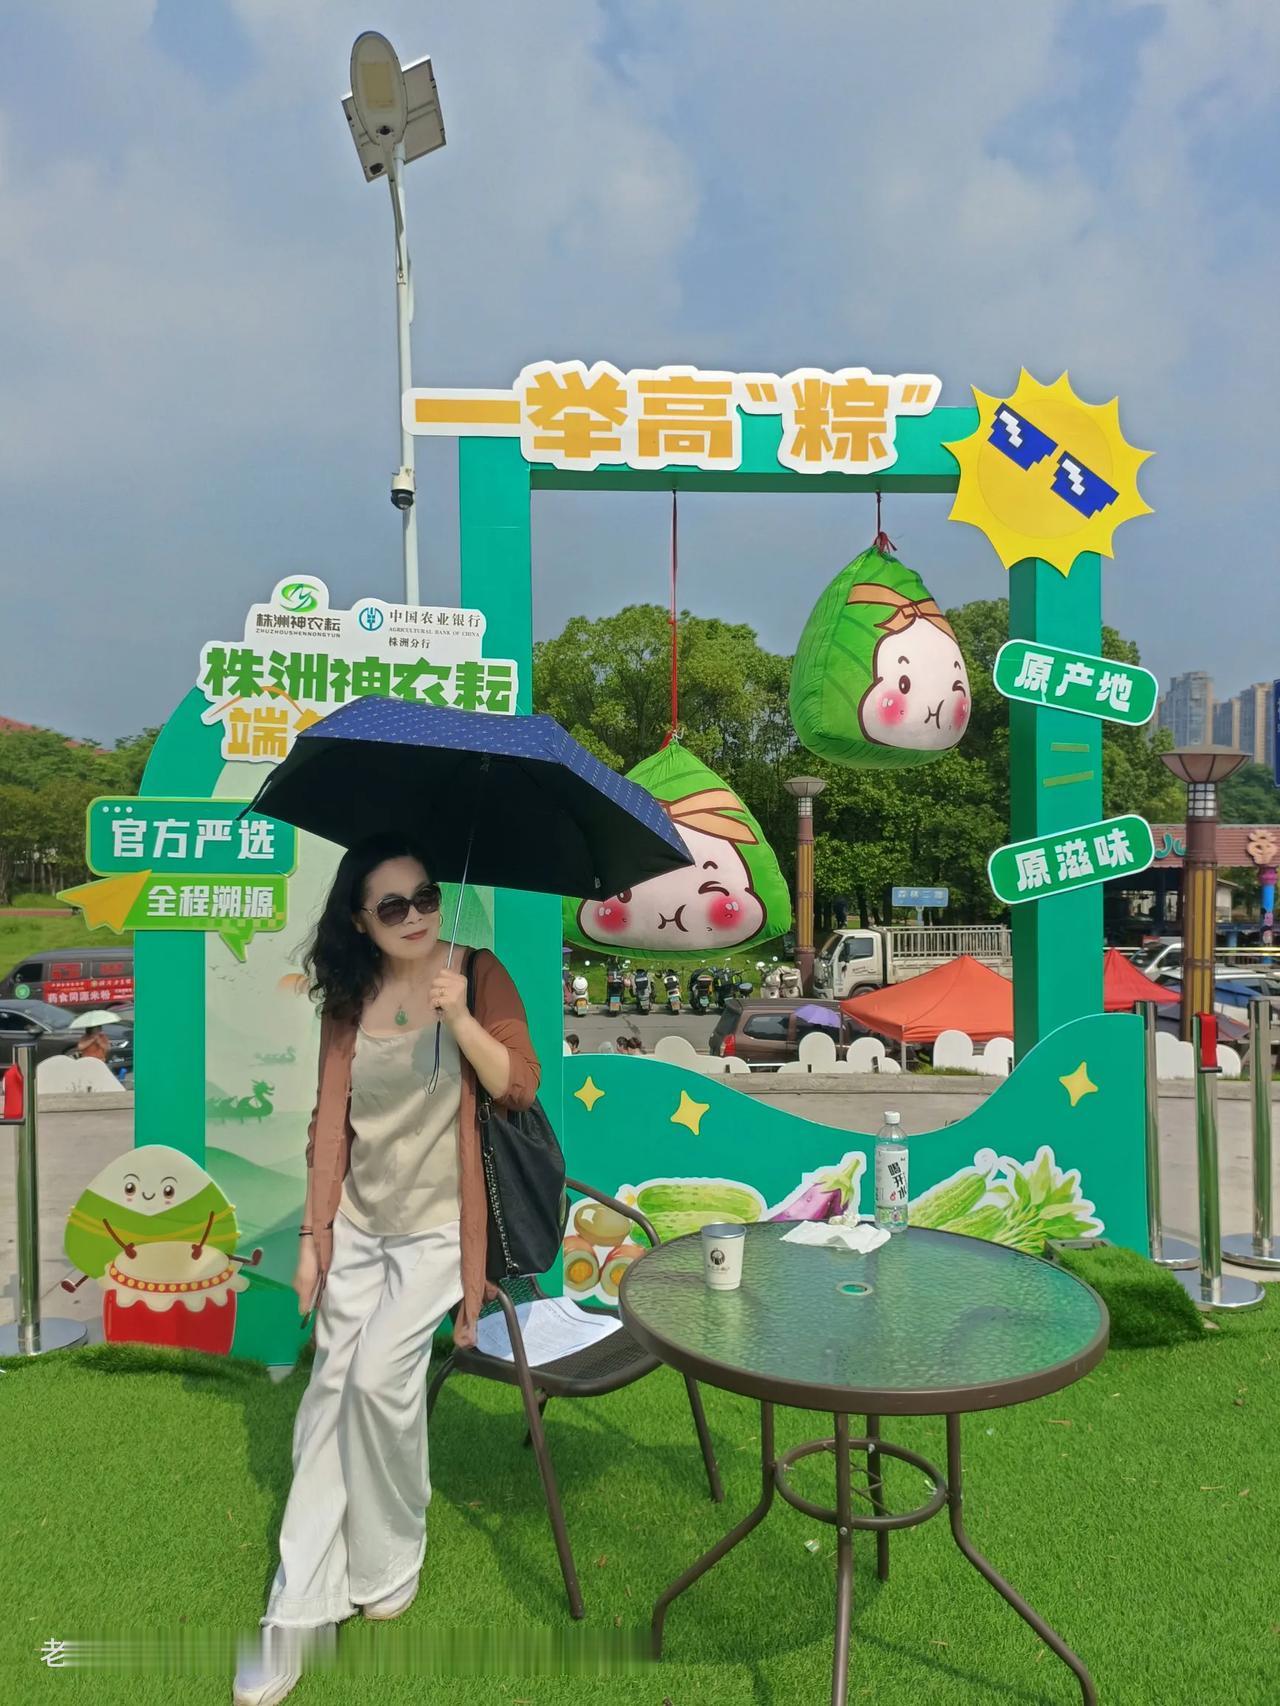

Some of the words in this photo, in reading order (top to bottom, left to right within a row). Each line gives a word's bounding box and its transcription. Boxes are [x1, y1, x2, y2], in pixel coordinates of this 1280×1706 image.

[256, 613, 341, 631] 株洲神农耘
[390, 609, 480, 627] 中国农业银行
[256, 628, 341, 637] ZHUZHOUSHENNONGYUN
[389, 627, 432, 635] AGRICULTURAL
[389, 637, 430, 648] 株洲分行
[203, 648, 511, 712] 株洲神农耘
[1014, 651, 1133, 712] 原产地
[112, 818, 274, 859] 官方严选
[1014, 828, 1134, 892] 原滋味
[147, 885, 274, 918] 全程溯源
